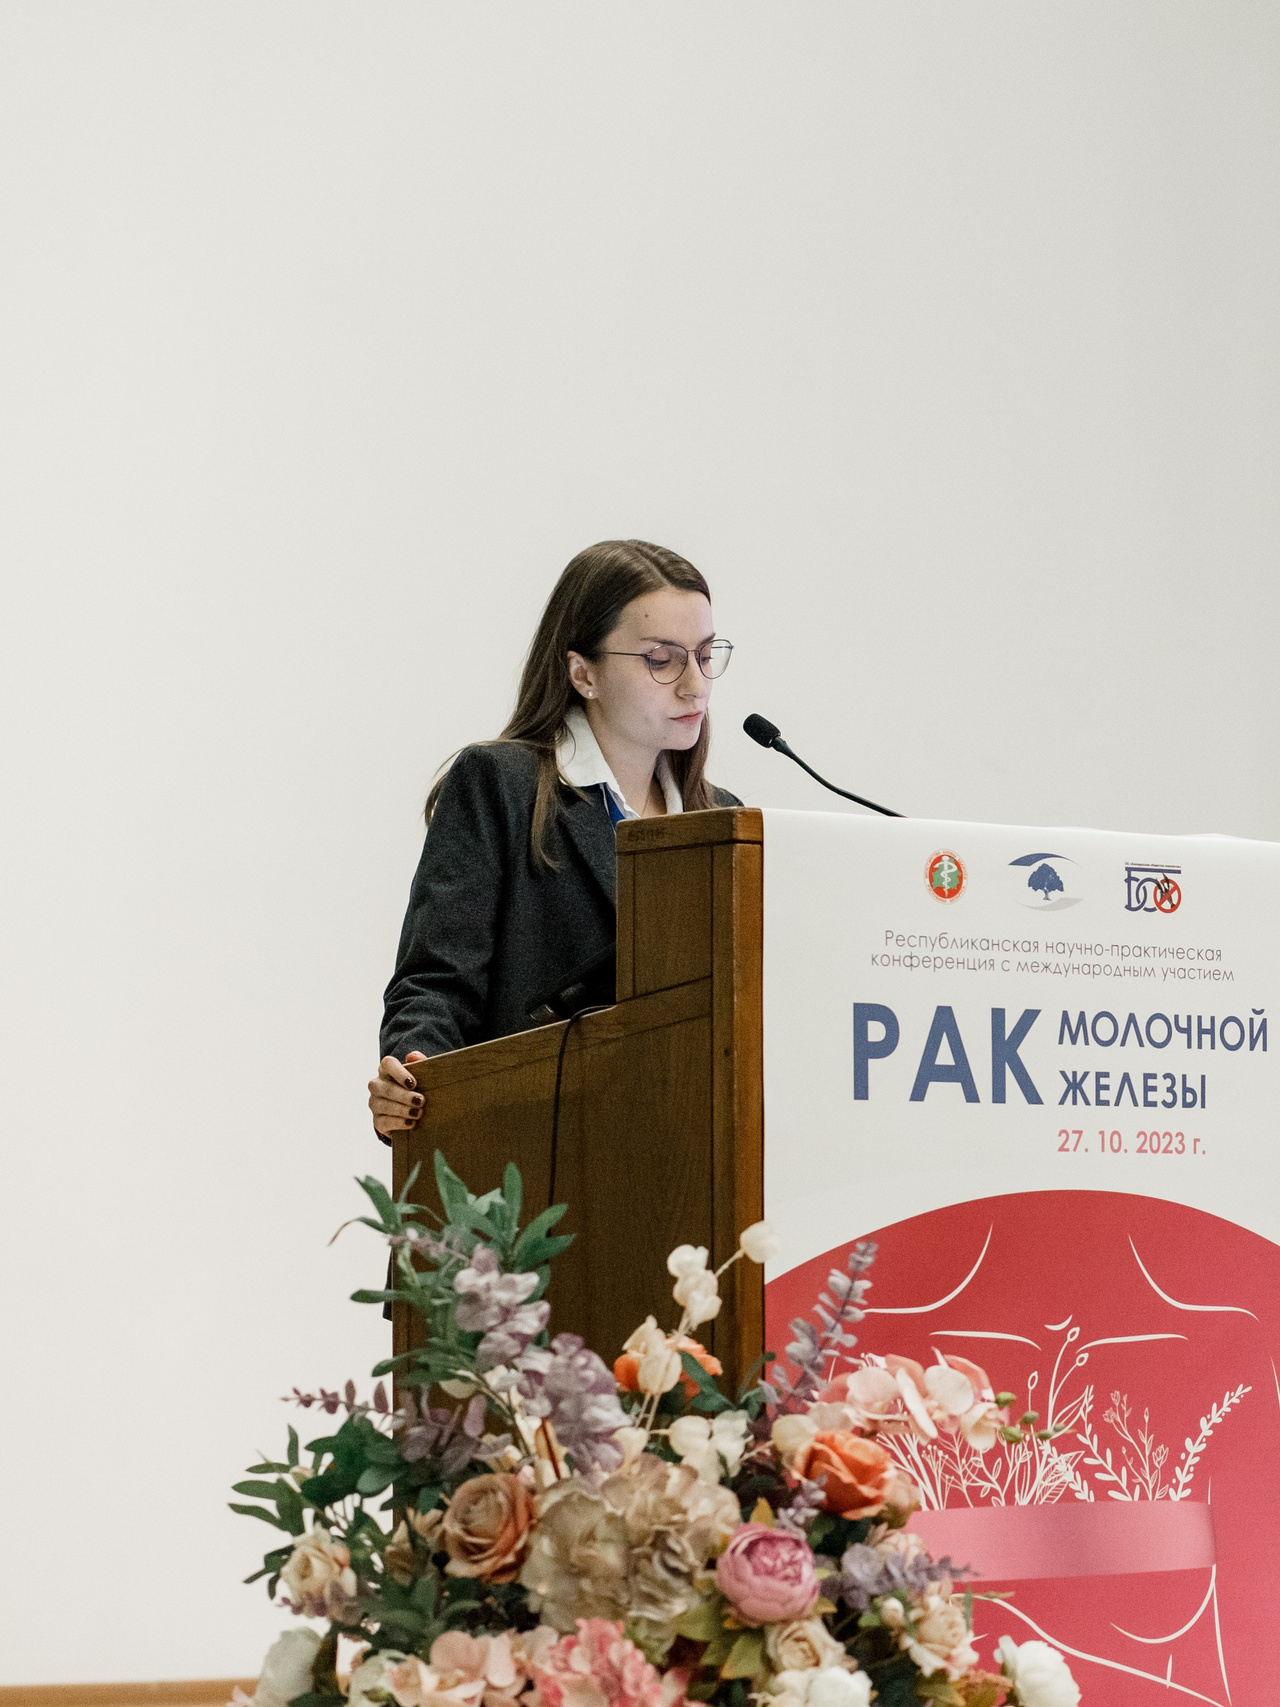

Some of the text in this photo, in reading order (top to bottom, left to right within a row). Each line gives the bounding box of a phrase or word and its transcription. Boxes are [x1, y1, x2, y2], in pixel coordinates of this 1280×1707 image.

[884, 929, 1223, 961] Республиканская научно-практическая
[871, 951, 1235, 982] конференция с международным участием
[1057, 1007, 1268, 1052] МОЛОЧНОЙ
[852, 1002, 1045, 1106] РАК
[1057, 1070, 1206, 1109] ЖЕЛЕЗЫ
[1057, 1129, 1207, 1155] 27. 10. 2023 г.
